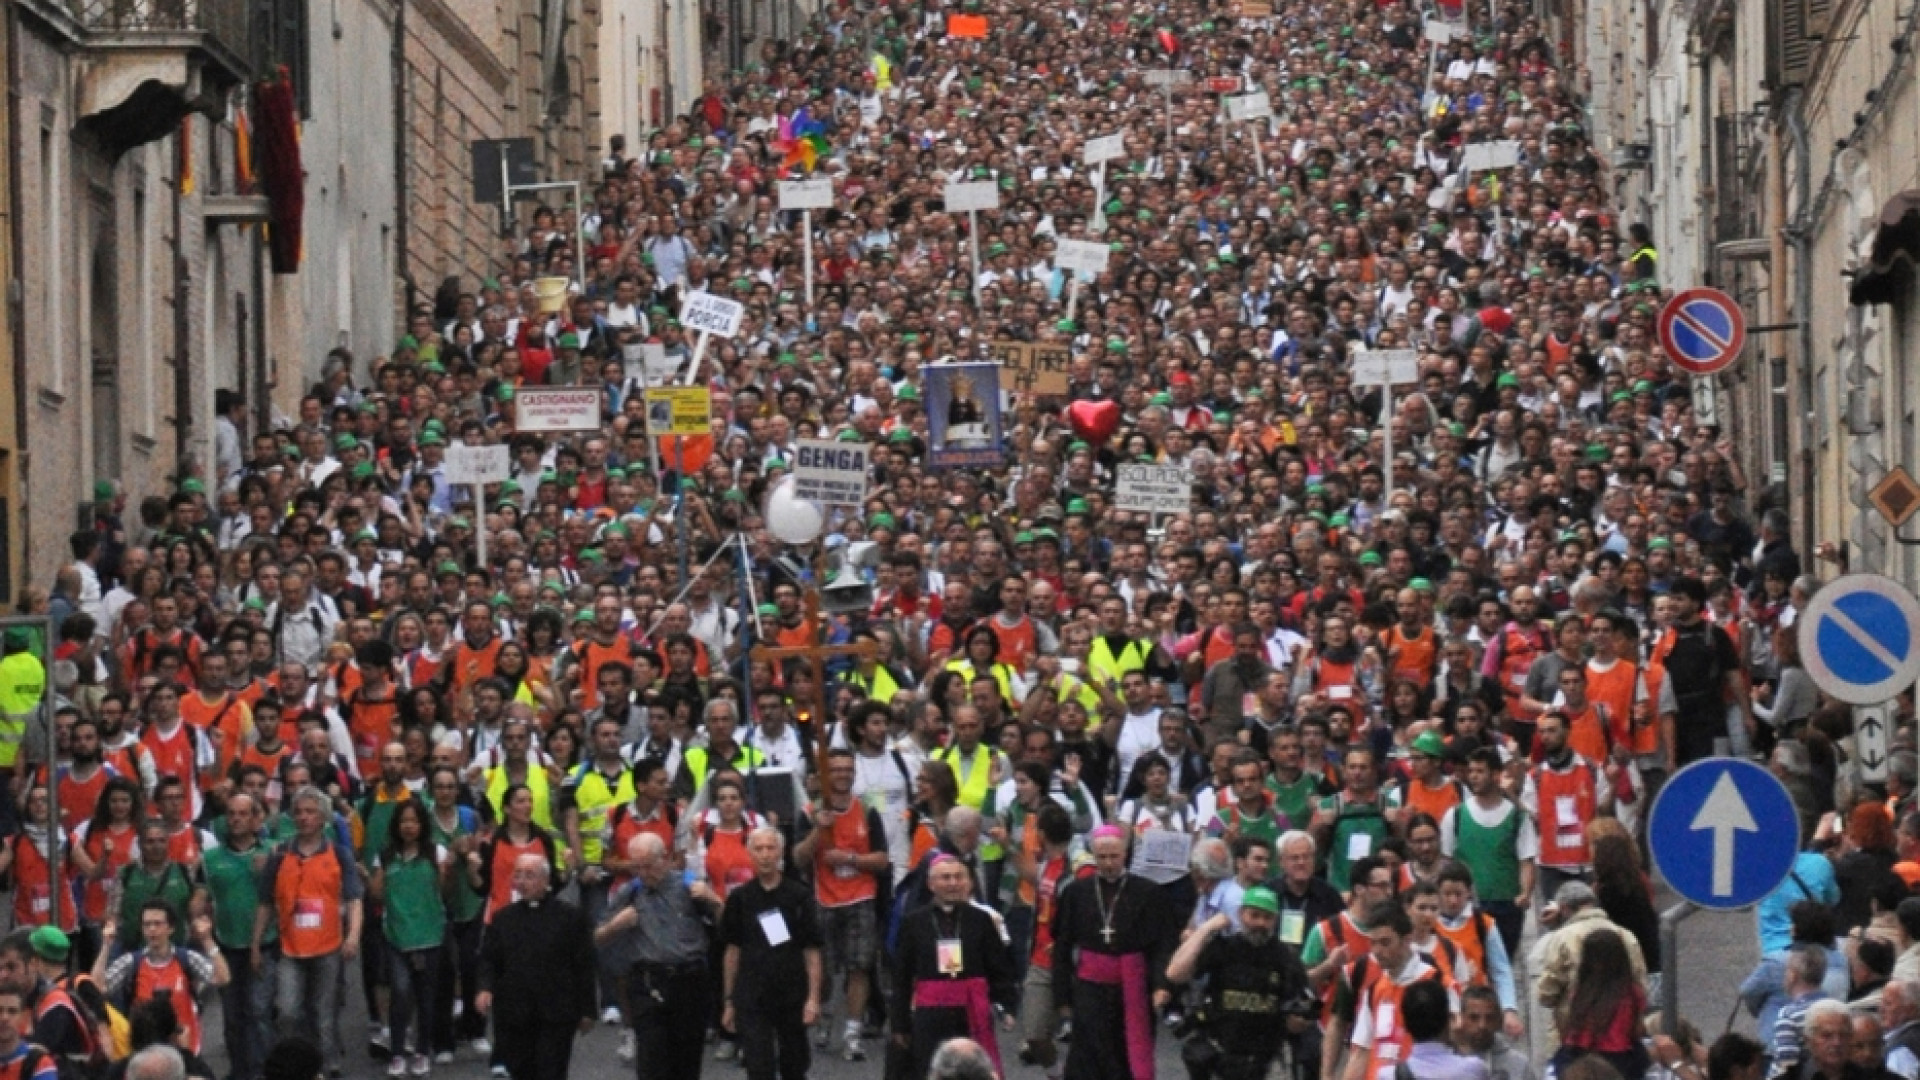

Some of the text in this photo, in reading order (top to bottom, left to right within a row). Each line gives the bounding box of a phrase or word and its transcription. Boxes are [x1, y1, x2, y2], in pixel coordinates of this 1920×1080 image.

[686, 307, 732, 333] PORCIA
[522, 393, 596, 405] CASTIGNANO
[798, 446, 865, 471] GENGA
